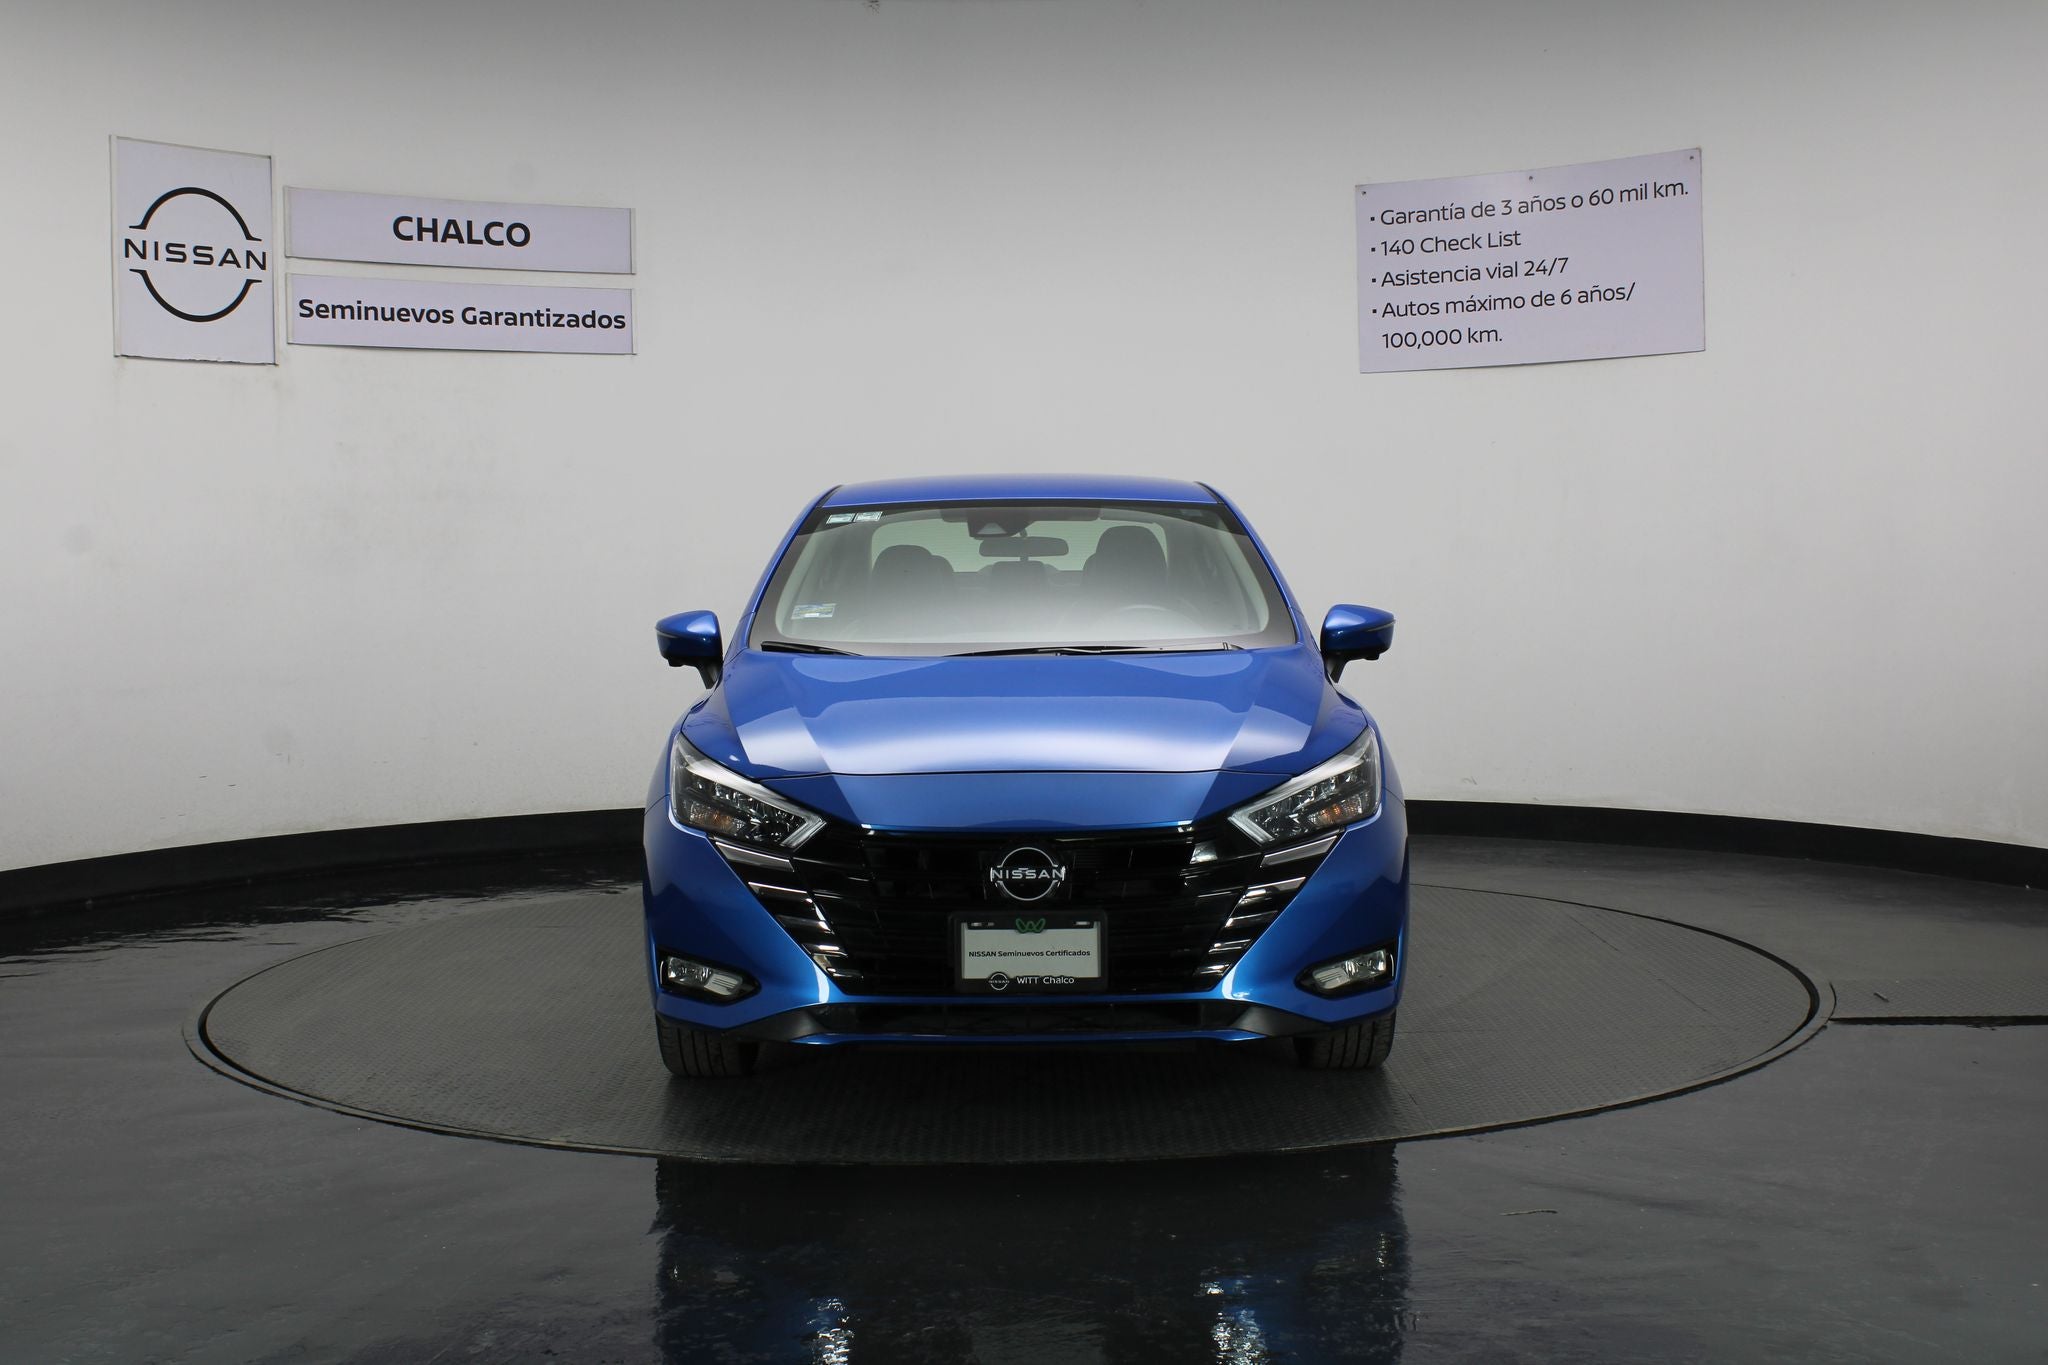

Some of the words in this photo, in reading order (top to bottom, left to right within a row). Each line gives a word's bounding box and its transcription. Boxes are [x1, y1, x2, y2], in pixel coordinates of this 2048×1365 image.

[1381, 203, 1465, 225] Garantía
[1471, 201, 1496, 218] de
[1501, 200, 1513, 216] 3
[1518, 195, 1566, 214] años
[1571, 195, 1583, 208] o
[1589, 188, 1614, 206] 60
[1620, 183, 1648, 203] mil
[1653, 181, 1689, 199] km.
[393, 216, 531, 247] CHALCO
[1381, 238, 1415, 256] 140
[1420, 233, 1482, 253] Check
[1487, 231, 1522, 248] List
[125, 239, 267, 270] NISSAN
[1381, 265, 1481, 287] Asistencia
[1486, 261, 1518, 279] vial
[1524, 257, 1569, 277] 24/7
[299, 299, 455, 325] Seminuevos
[462, 307, 626, 330] Garantizados
[1381, 300, 1440, 318] Autos
[1446, 295, 1525, 314] máximo
[1531, 290, 1556, 307] de
[1561, 289, 1572, 305] 6
[1578, 282, 1636, 304] años/
[1381, 328, 1463, 349] 100,000
[1468, 327, 1503, 343] km.
[991, 869, 1065, 880] NISSAN
[1017, 976, 1039, 984] WITT
[1043, 976, 1075, 984] Chalco
